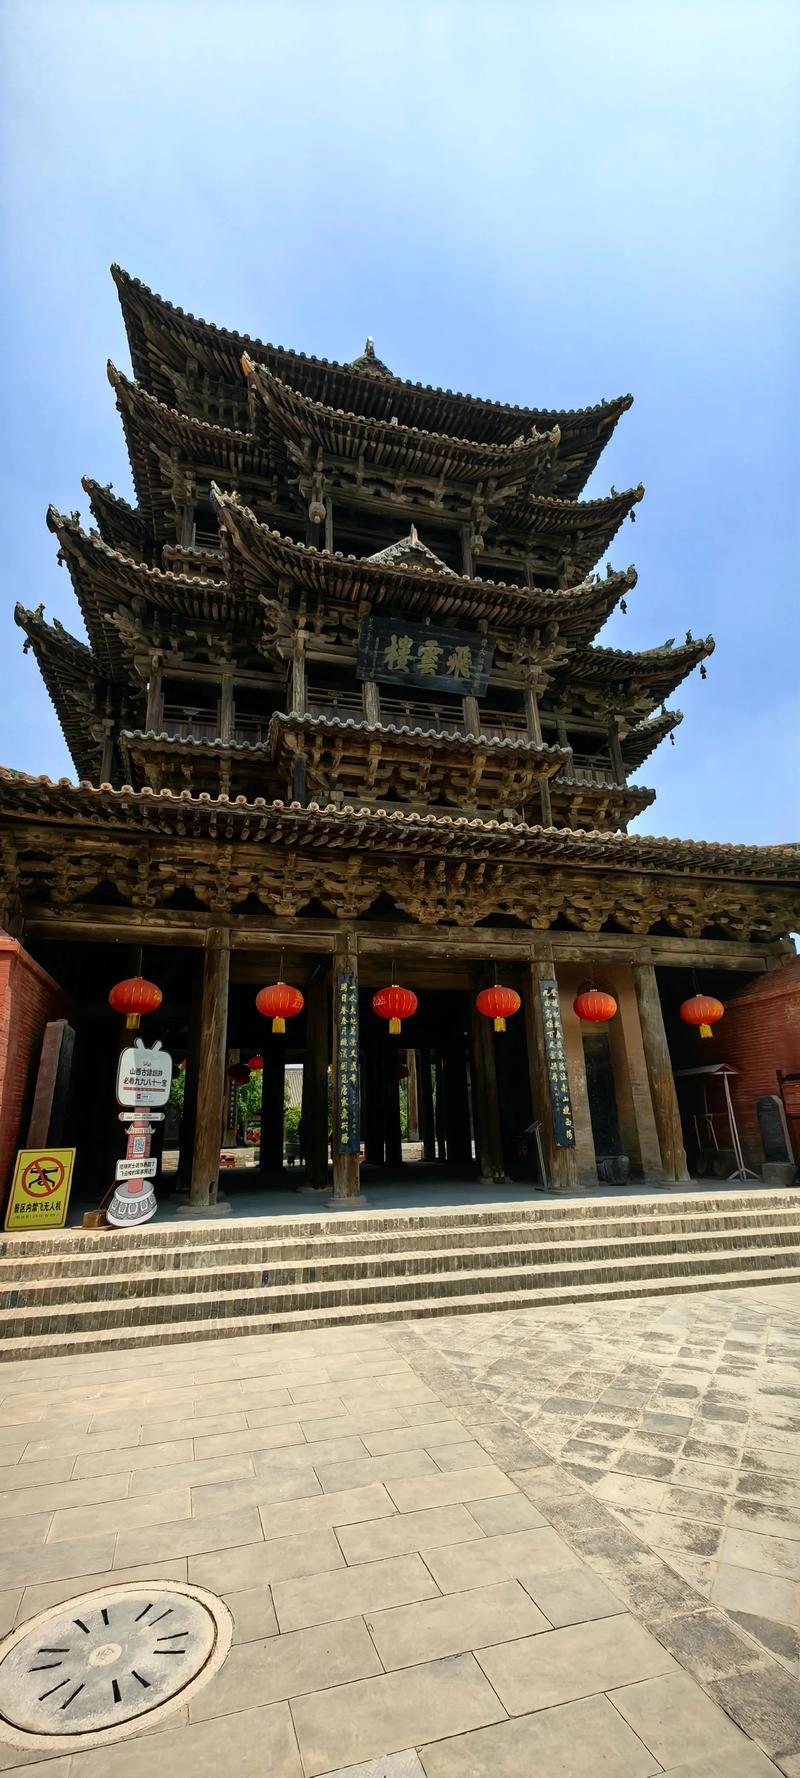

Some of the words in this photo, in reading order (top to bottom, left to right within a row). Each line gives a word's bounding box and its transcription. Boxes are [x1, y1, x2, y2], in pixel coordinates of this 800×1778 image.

[14, 1201, 62, 1213] 景区内禁飞无人机
